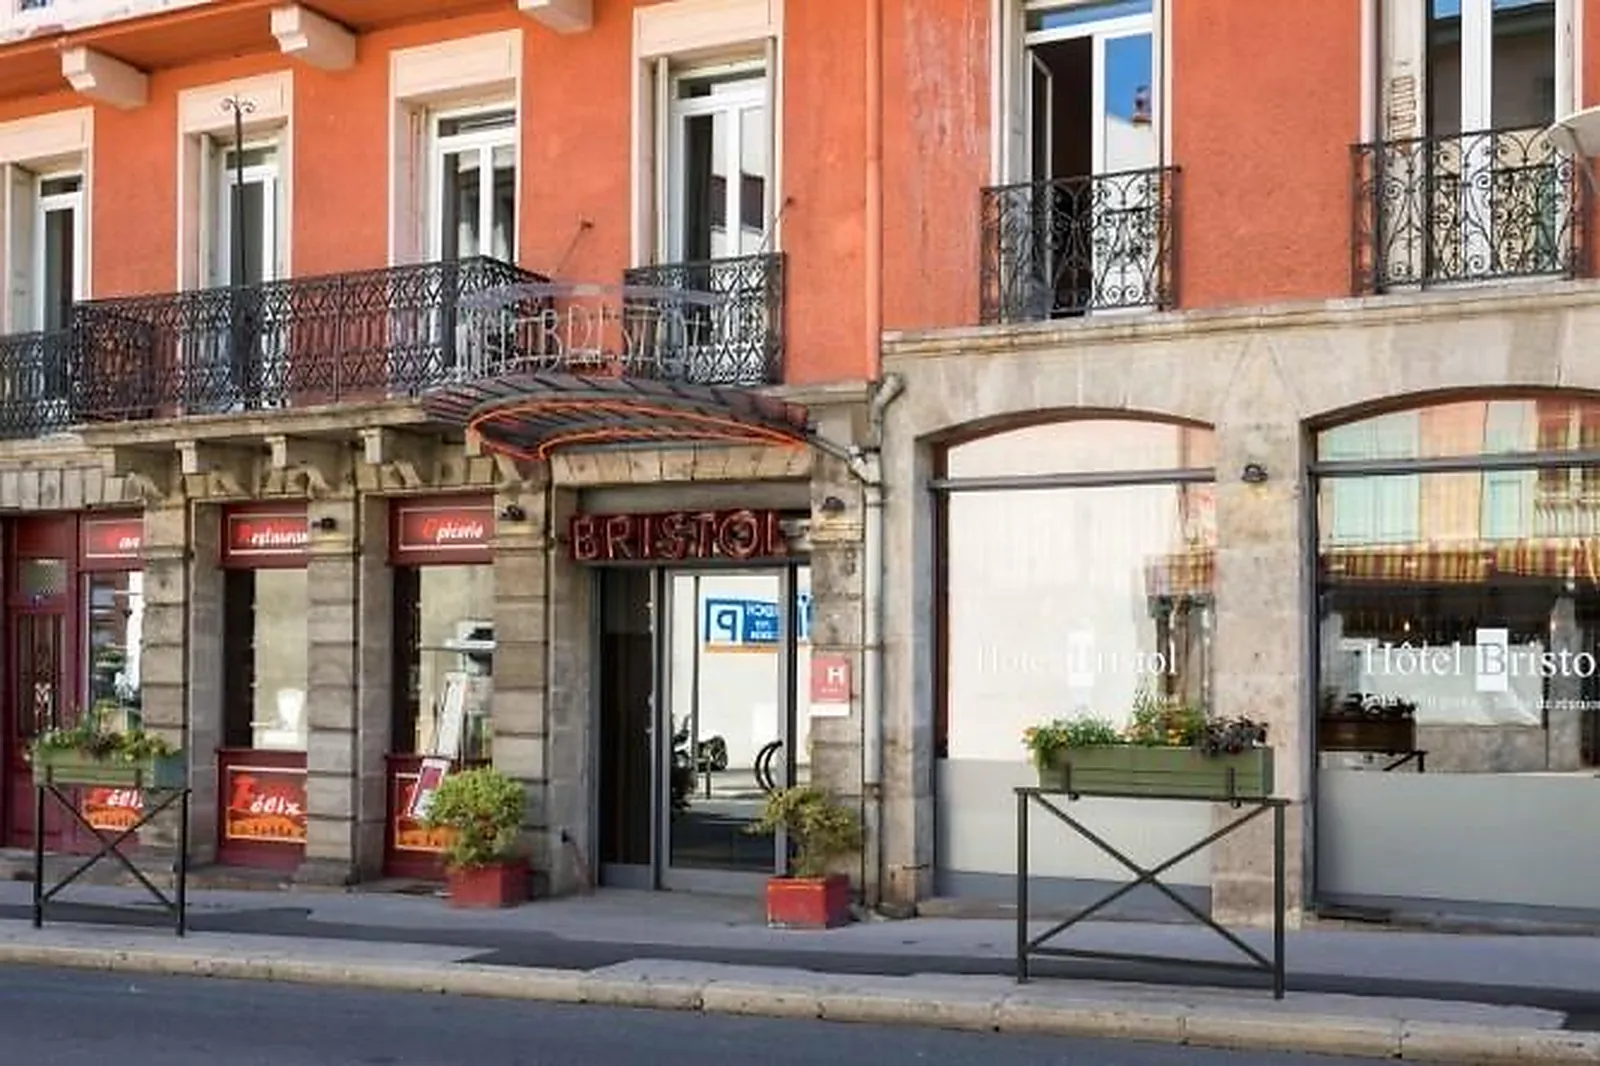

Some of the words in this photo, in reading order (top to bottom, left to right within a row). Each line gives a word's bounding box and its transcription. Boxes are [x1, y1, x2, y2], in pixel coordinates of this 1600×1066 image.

[565, 508, 787, 560] BRISTOL
[827, 666, 845, 685] H
[1363, 640, 1464, 677] Hôtel
